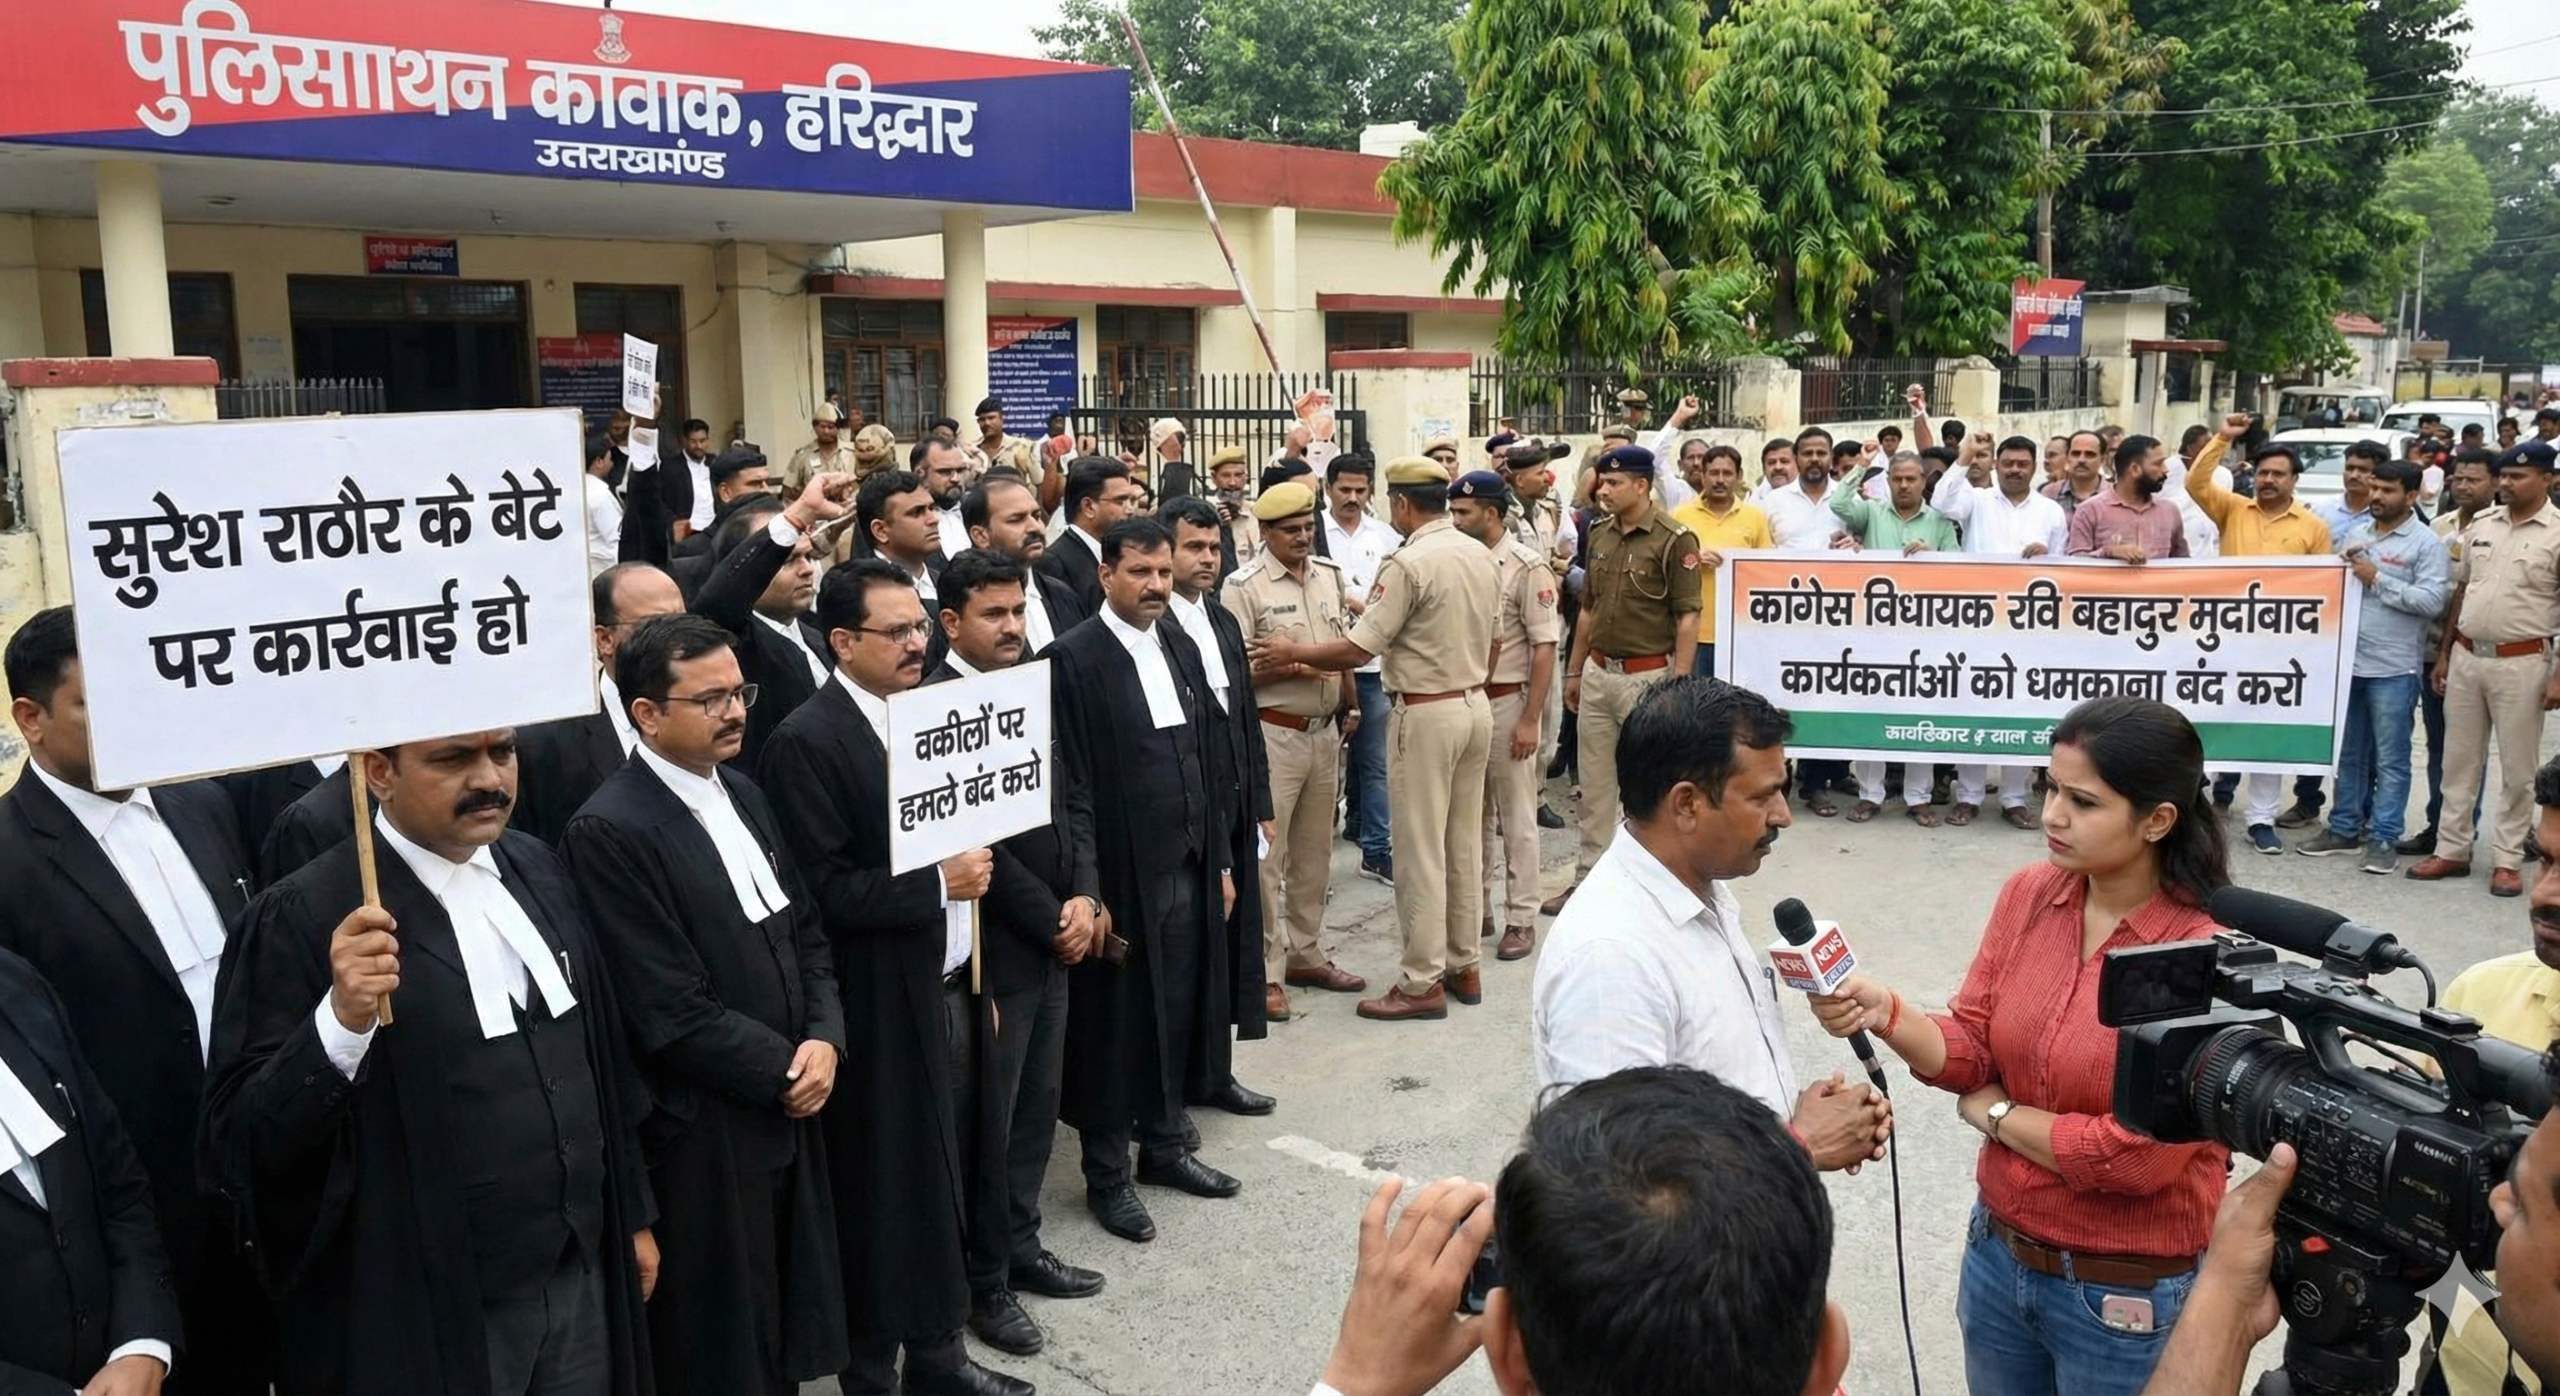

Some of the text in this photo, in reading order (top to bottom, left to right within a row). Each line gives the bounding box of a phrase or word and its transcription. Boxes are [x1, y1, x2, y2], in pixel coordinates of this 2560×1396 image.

[89, 469, 562, 608] सुरेश राठौर के बेटे
[149, 576, 529, 688] पर कार्रवाई हो
[1864, 578, 1996, 627] विधायक
[2008, 581, 2062, 629] रवि
[2073, 597, 2183, 650] बहादुर
[2190, 584, 2323, 651] मुर्दाबाद
[1781, 648, 2306, 706] कार्यकर्ताओं को धमकाना बंद करो
[915, 703, 1024, 760] वकीलों पर
[899, 749, 1041, 831] हमले बंद करो
[1815, 933, 1844, 967] NEWS
